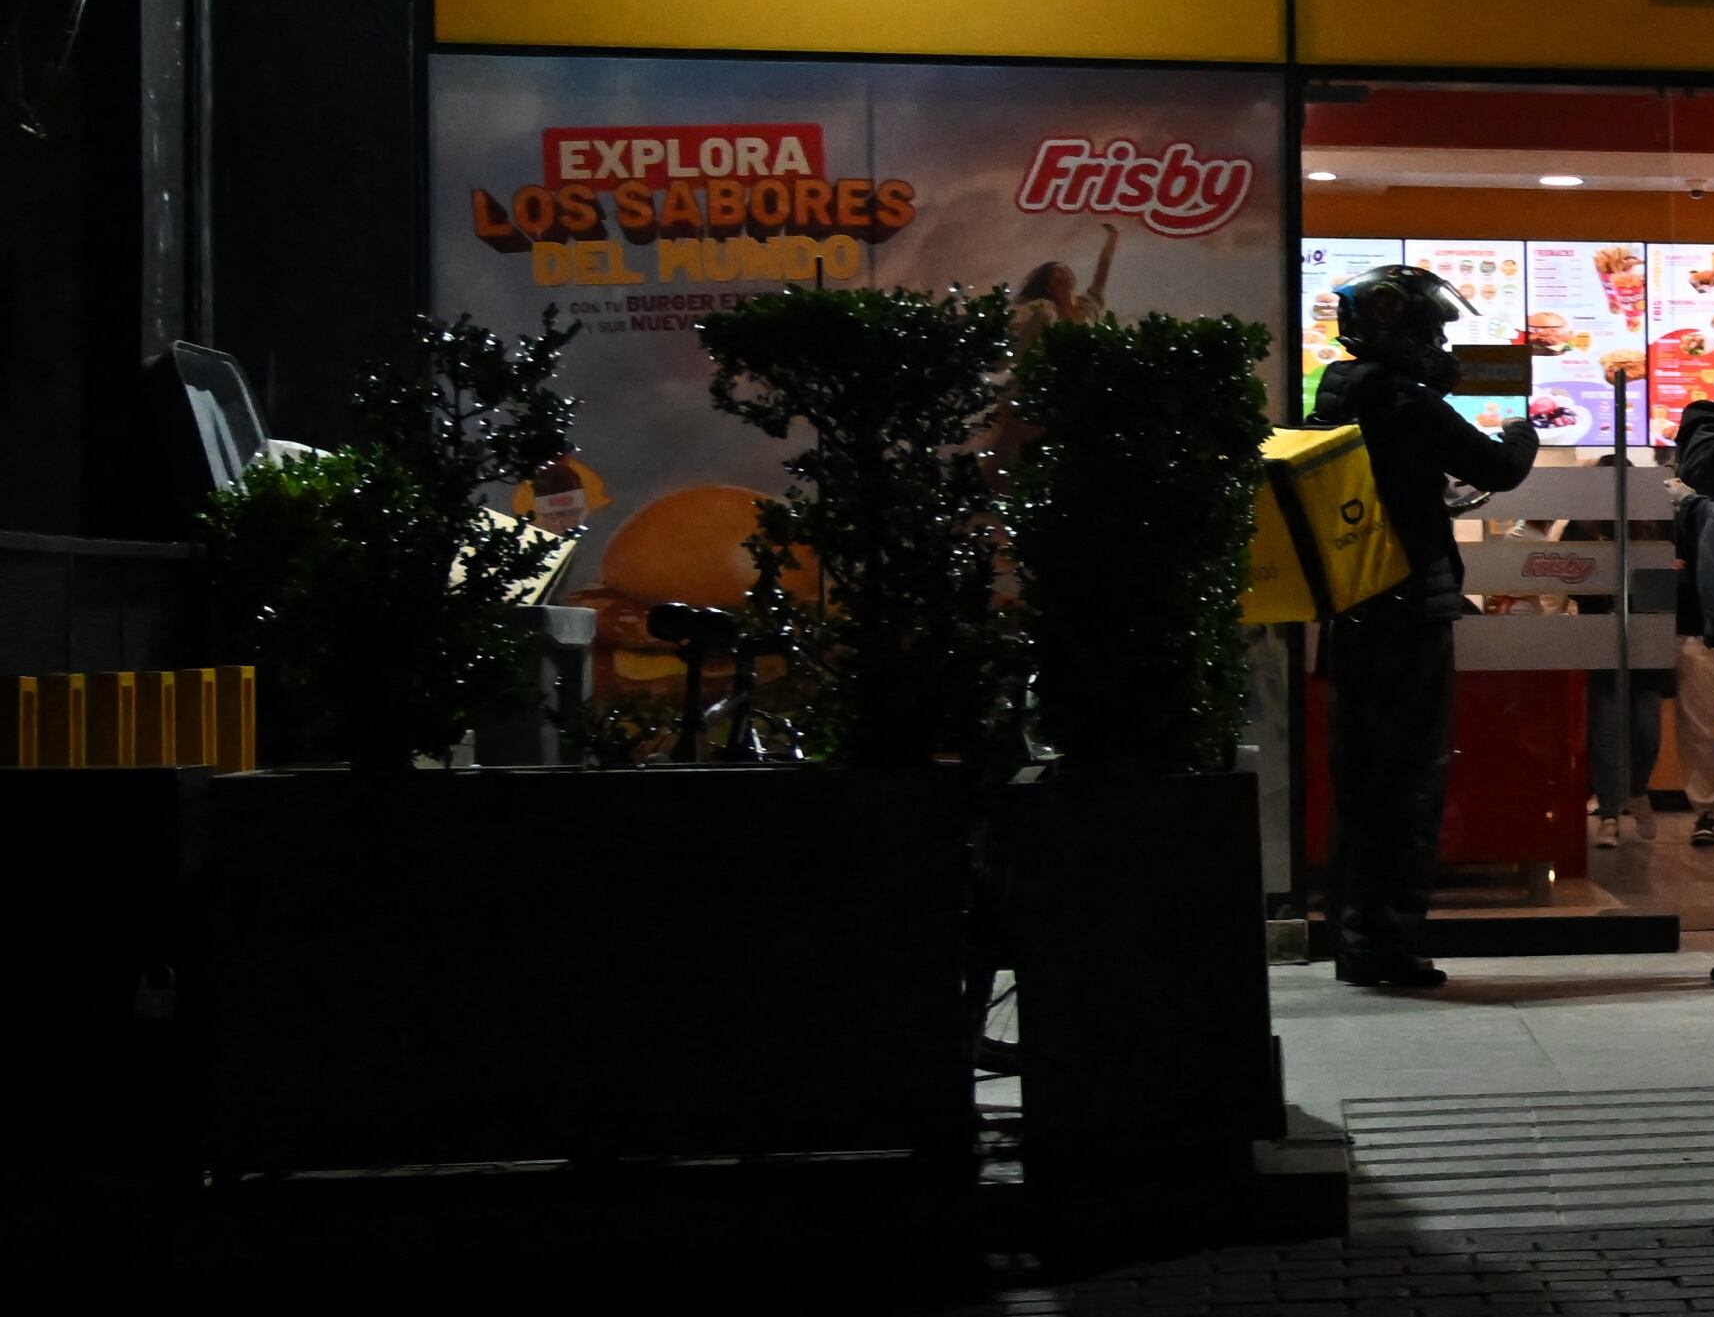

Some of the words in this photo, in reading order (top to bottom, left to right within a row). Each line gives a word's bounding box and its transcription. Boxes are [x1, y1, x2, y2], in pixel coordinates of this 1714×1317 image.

[558, 136, 813, 180] EXPLORA
[471, 183, 606, 242] LOS
[613, 178, 917, 238] SABORES
[1018, 137, 1252, 236] Frisby
[532, 238, 646, 288] DEL
[657, 232, 864, 283] MUNDO
[626, 293, 715, 313] BURGER
